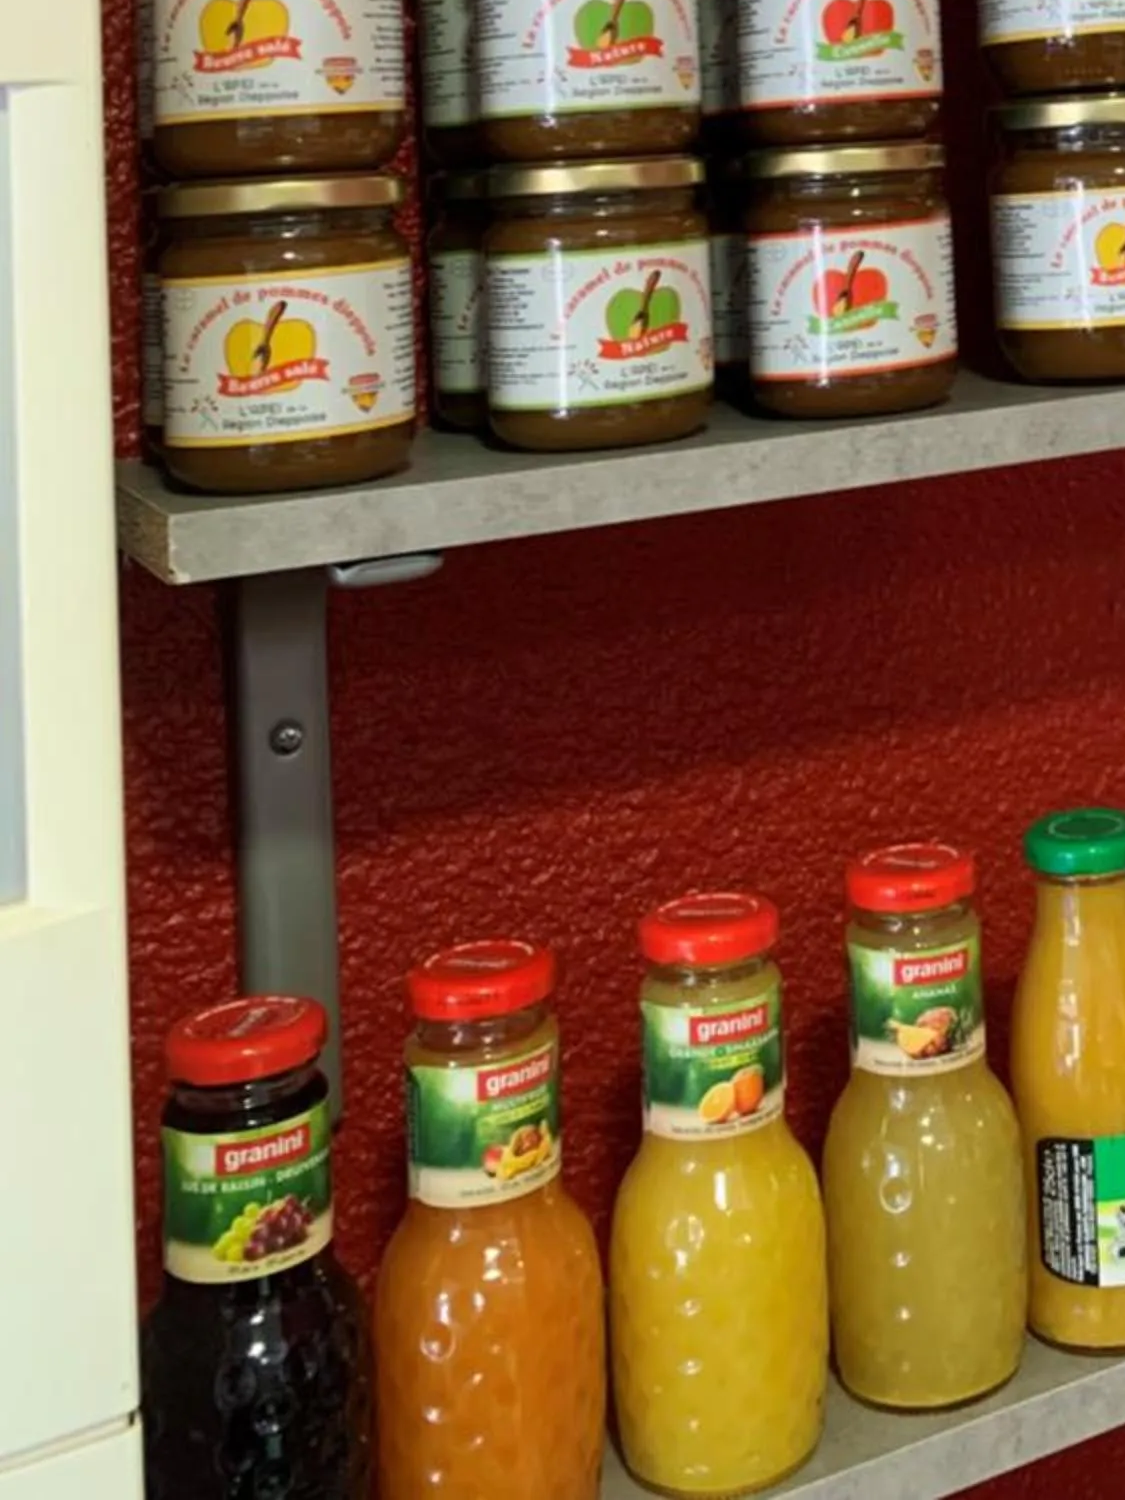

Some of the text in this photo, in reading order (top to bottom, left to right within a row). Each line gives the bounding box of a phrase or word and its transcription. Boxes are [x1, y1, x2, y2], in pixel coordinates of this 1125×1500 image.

[589, 42, 646, 64] Nature
[188, 297, 228, 350] caramel
[233, 290, 251, 304] de
[620, 329, 674, 355] Nature
[902, 953, 964, 983] granini
[697, 1009, 764, 1042] granini
[486, 1058, 550, 1096] granini
[224, 1130, 304, 1172] granini
